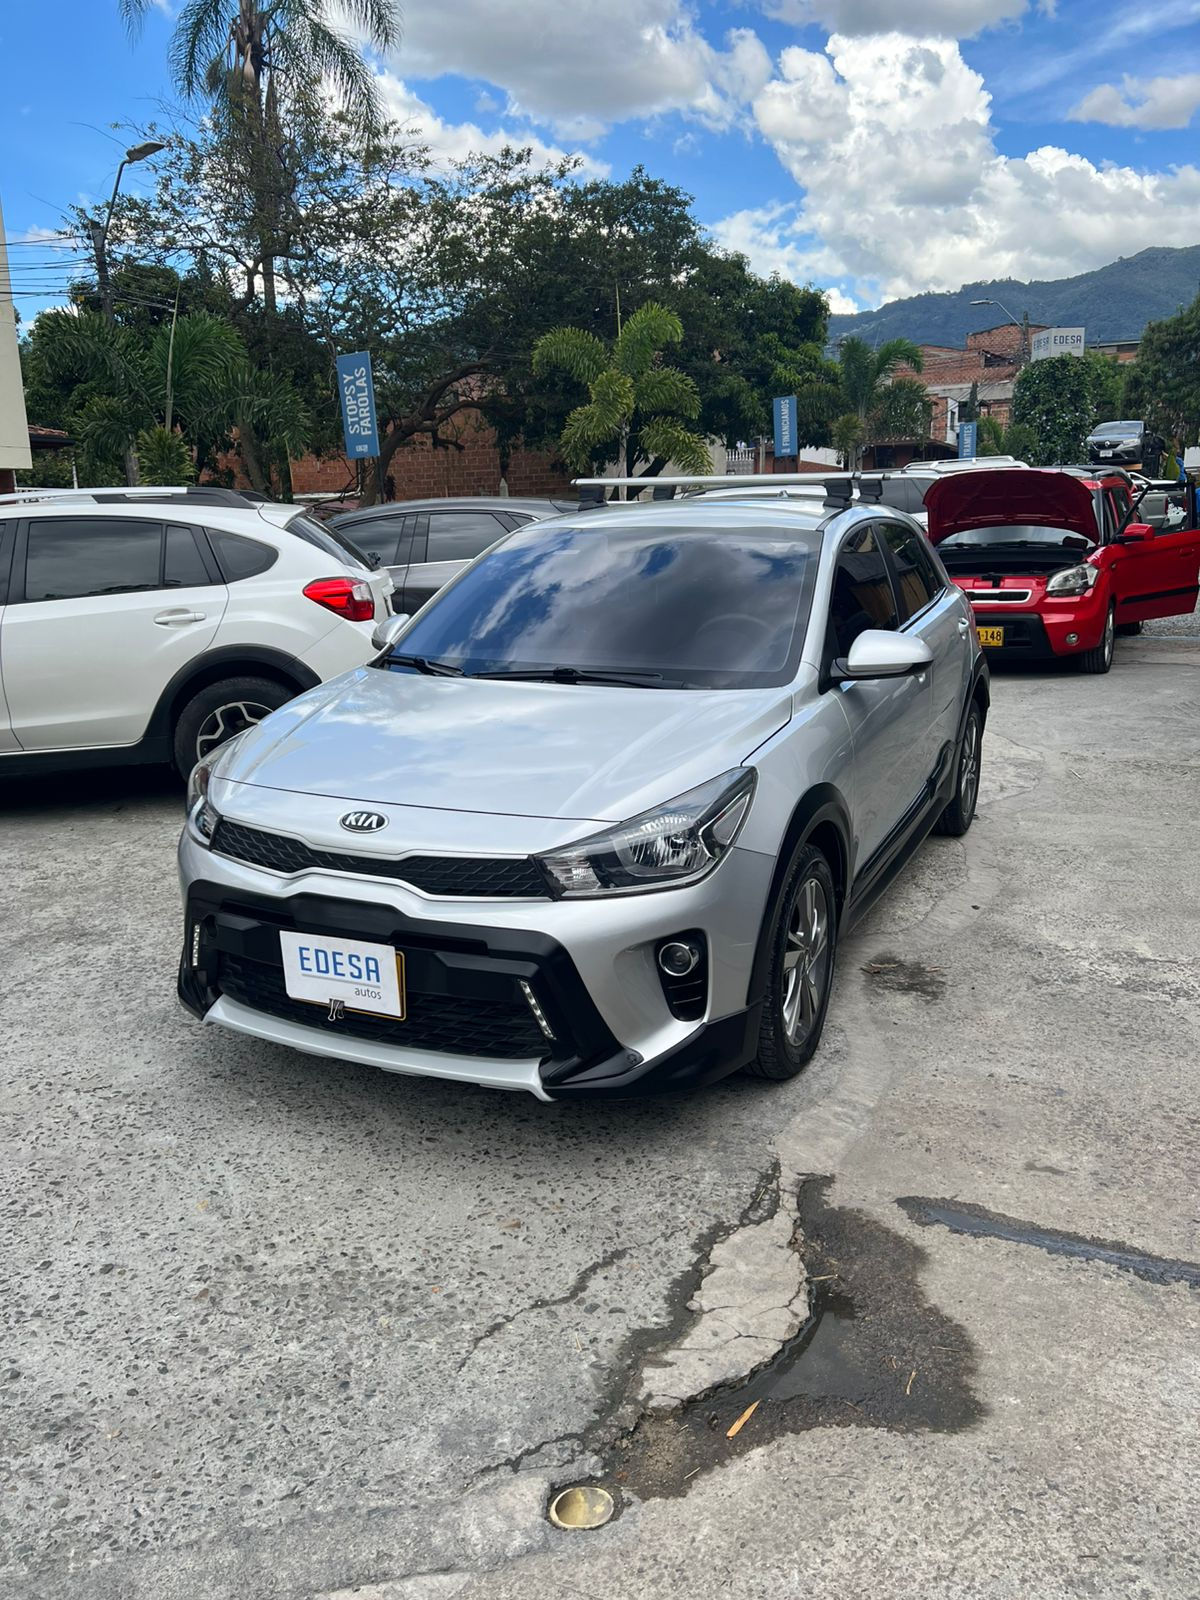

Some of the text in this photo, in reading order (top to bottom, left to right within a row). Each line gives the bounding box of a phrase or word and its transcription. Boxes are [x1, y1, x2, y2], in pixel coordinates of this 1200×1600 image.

[1053, 335, 1082, 345] EDESA
[342, 374, 360, 434] STOPS Y
[354, 366, 372, 436] FAROLAS
[781, 399, 790, 447] FINANCIAMOS
[345, 812, 379, 829] KIA
[298, 946, 381, 983] EDESA
[354, 987, 382, 1000] autos
